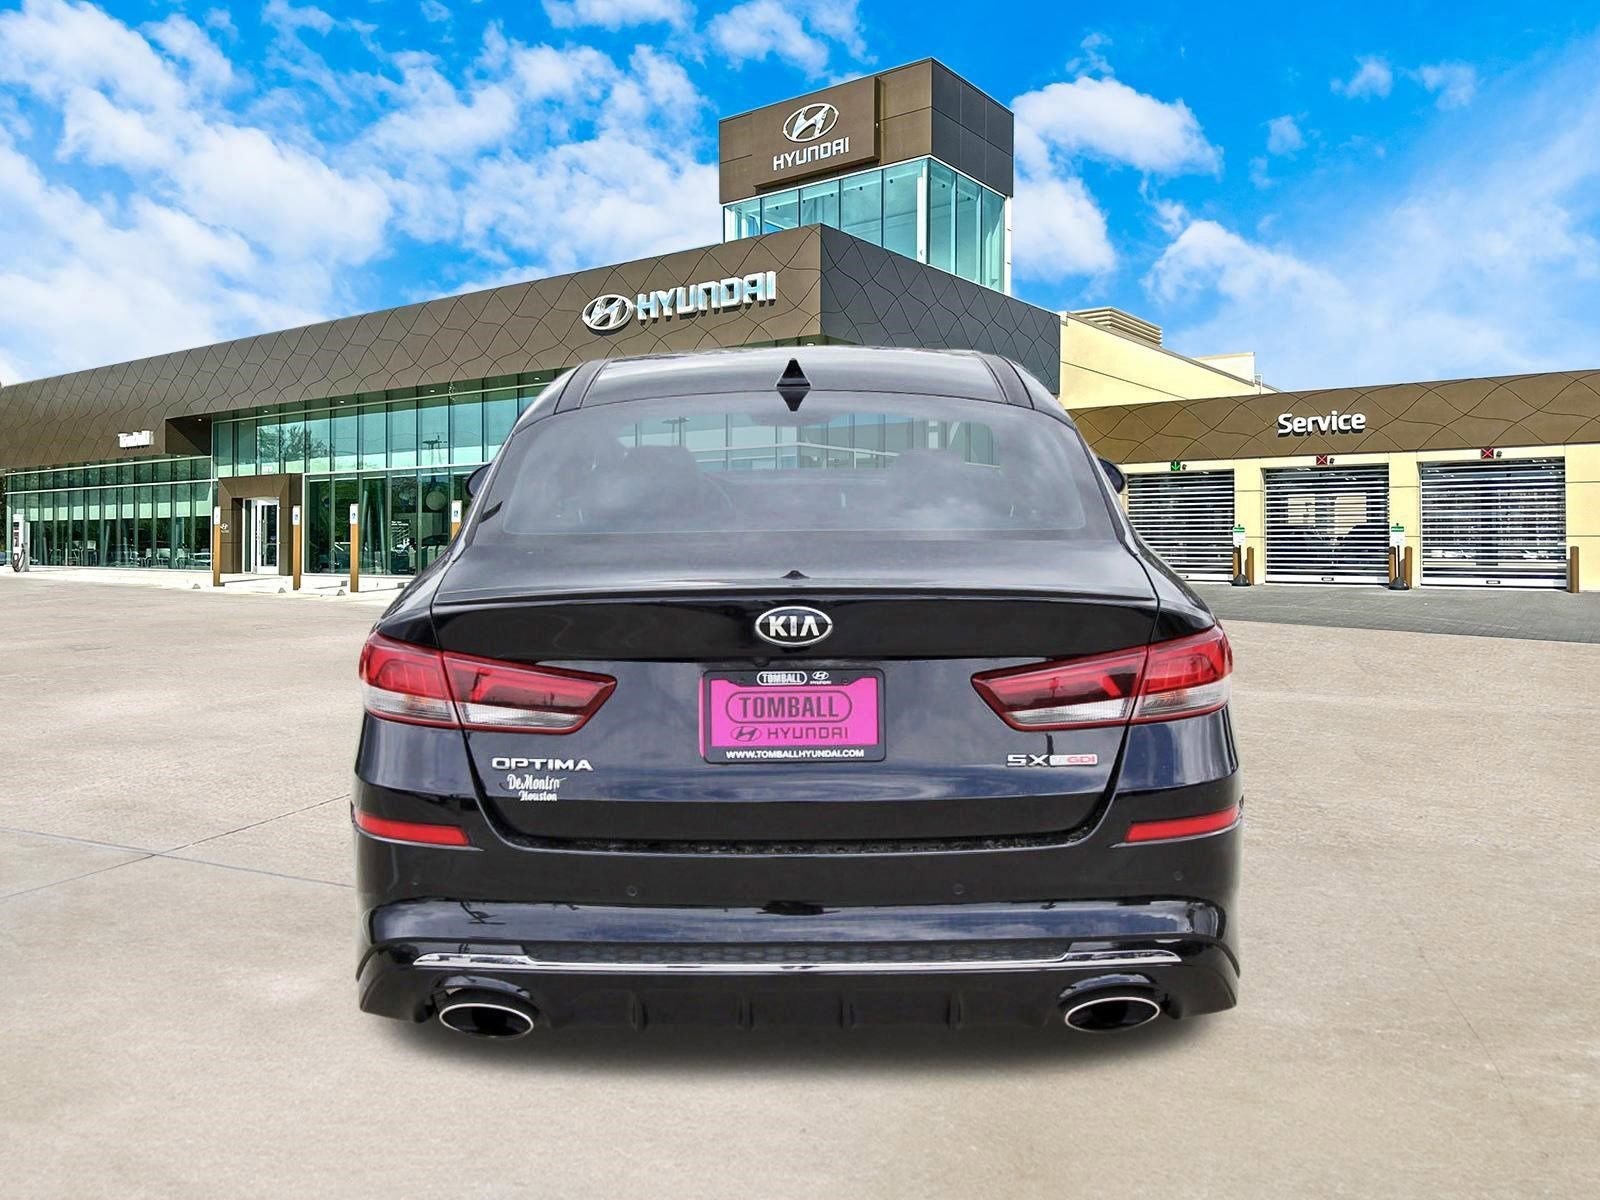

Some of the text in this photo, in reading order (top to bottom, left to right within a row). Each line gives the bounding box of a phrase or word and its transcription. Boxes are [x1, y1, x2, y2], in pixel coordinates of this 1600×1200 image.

[773, 137, 849, 171] HYUNDAI
[636, 270, 777, 321] HYUNDAI
[1277, 410, 1367, 435] Service
[768, 615, 820, 637] KIA
[762, 673, 802, 683] TOMBALL
[739, 696, 839, 718] TOMBALL
[767, 727, 848, 739] HYUNDAI
[726, 749, 864, 759] WWW.TOMBALLHYUNDAI.COM
[1006, 754, 1049, 766] SX
[491, 757, 594, 771] OPTIMA
[518, 790, 558, 802] Houston
